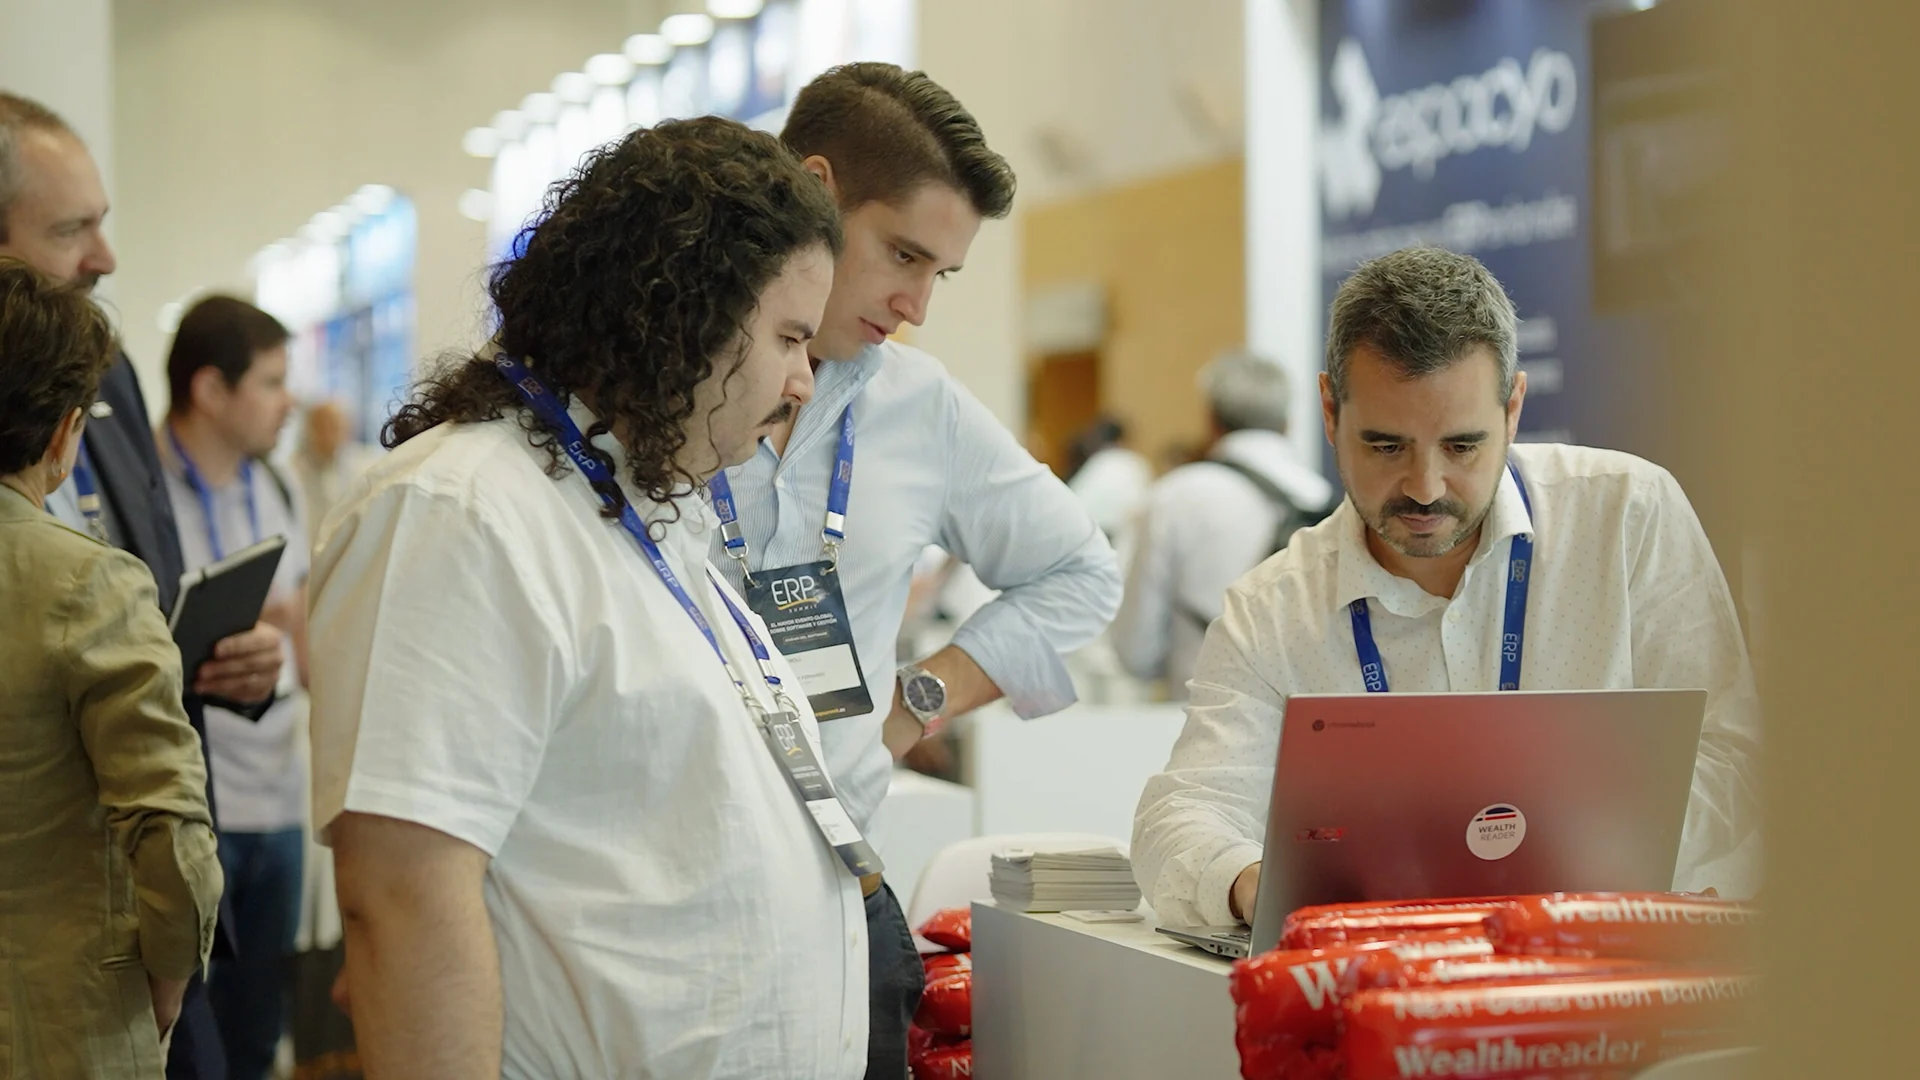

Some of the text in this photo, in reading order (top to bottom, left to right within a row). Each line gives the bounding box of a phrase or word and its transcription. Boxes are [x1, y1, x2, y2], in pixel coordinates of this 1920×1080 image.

[569, 440, 597, 470] ERP
[718, 499, 733, 522] ERP
[654, 559, 679, 588] ERP
[1512, 559, 1526, 584] ERP
[771, 575, 815, 606] ERP
[1503, 633, 1518, 662] ERP
[1363, 662, 1382, 691] ERP
[1478, 823, 1516, 833] WEALTH
[1480, 831, 1516, 841] READER
[1392, 1033, 1645, 1078] Wealthreader
